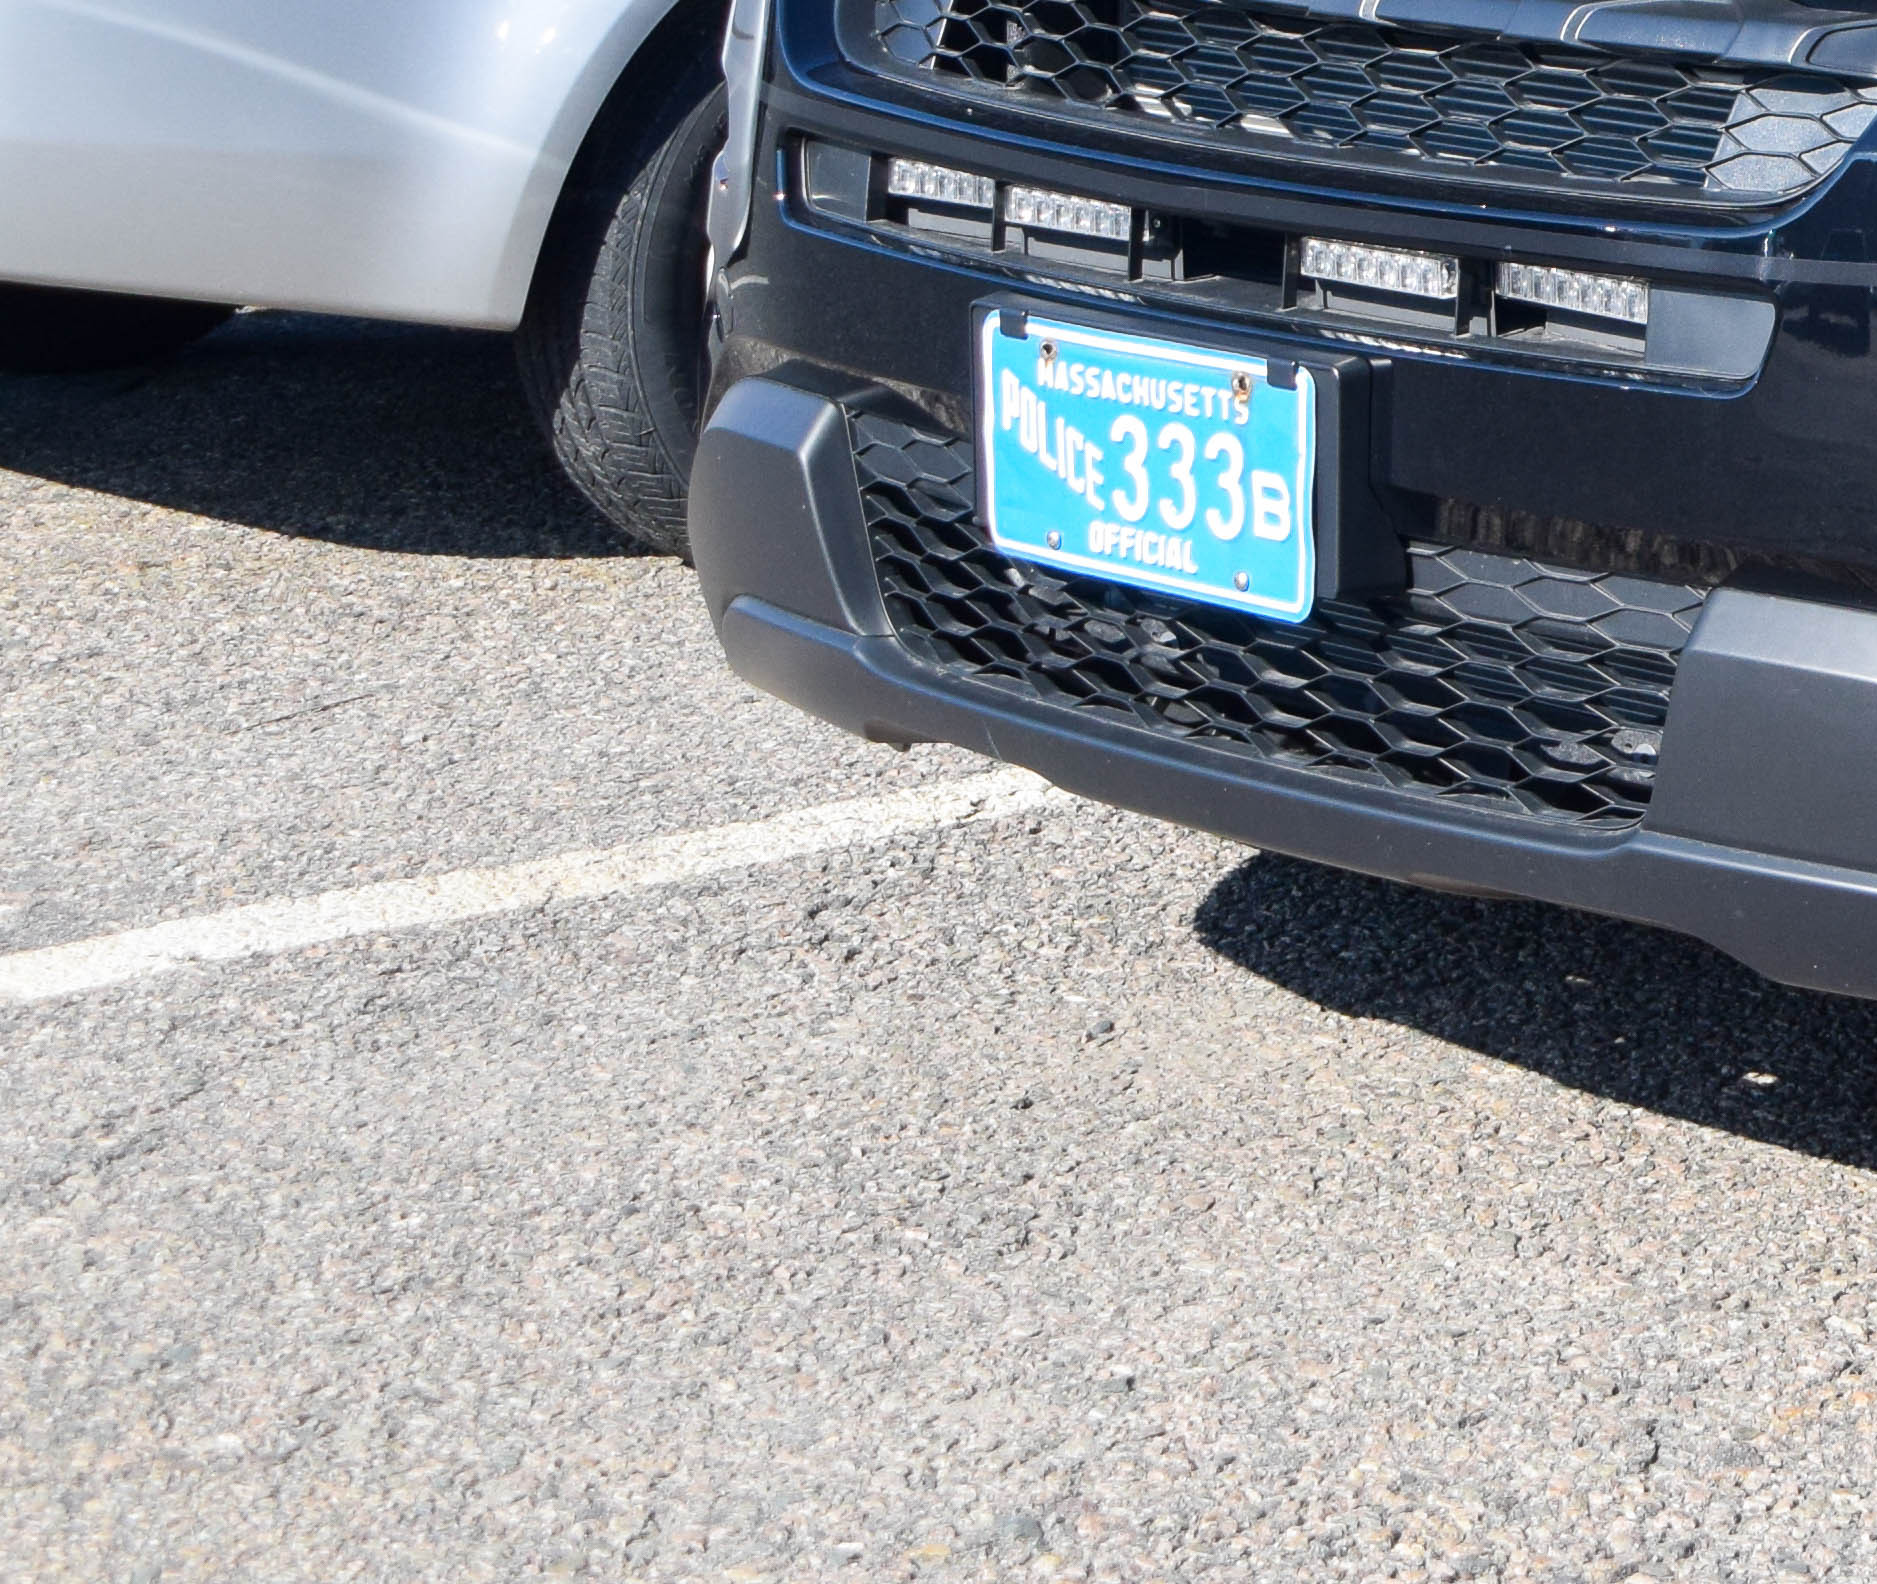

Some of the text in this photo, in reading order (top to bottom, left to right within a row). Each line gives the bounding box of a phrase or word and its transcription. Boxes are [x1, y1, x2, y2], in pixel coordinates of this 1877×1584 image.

[1037, 358, 1250, 426] MASSACHUSETTS
[1000, 369, 1105, 511] POLICE
[1088, 519, 1199, 575] OFFICIAL
